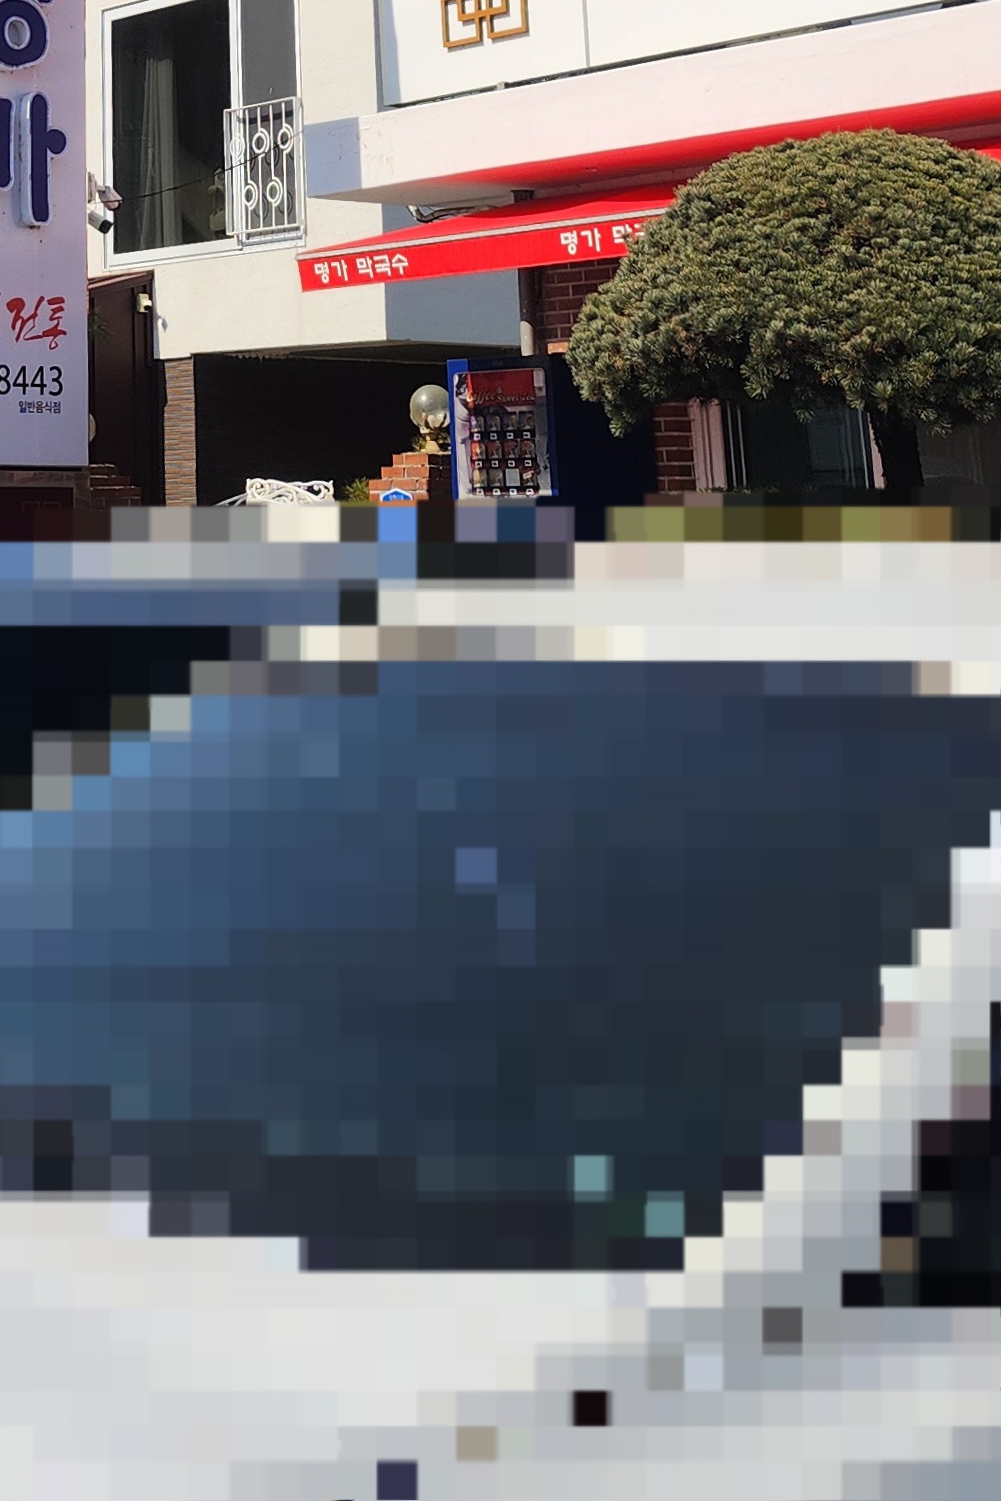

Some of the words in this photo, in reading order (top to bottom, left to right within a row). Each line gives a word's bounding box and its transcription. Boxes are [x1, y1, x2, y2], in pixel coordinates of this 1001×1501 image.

[560, 227, 601, 255] 명가
[314, 259, 348, 284] 명가
[356, 253, 409, 278] 막국수
[6, 296, 67, 350] 전통
[18, 401, 61, 414] 일반음식점
